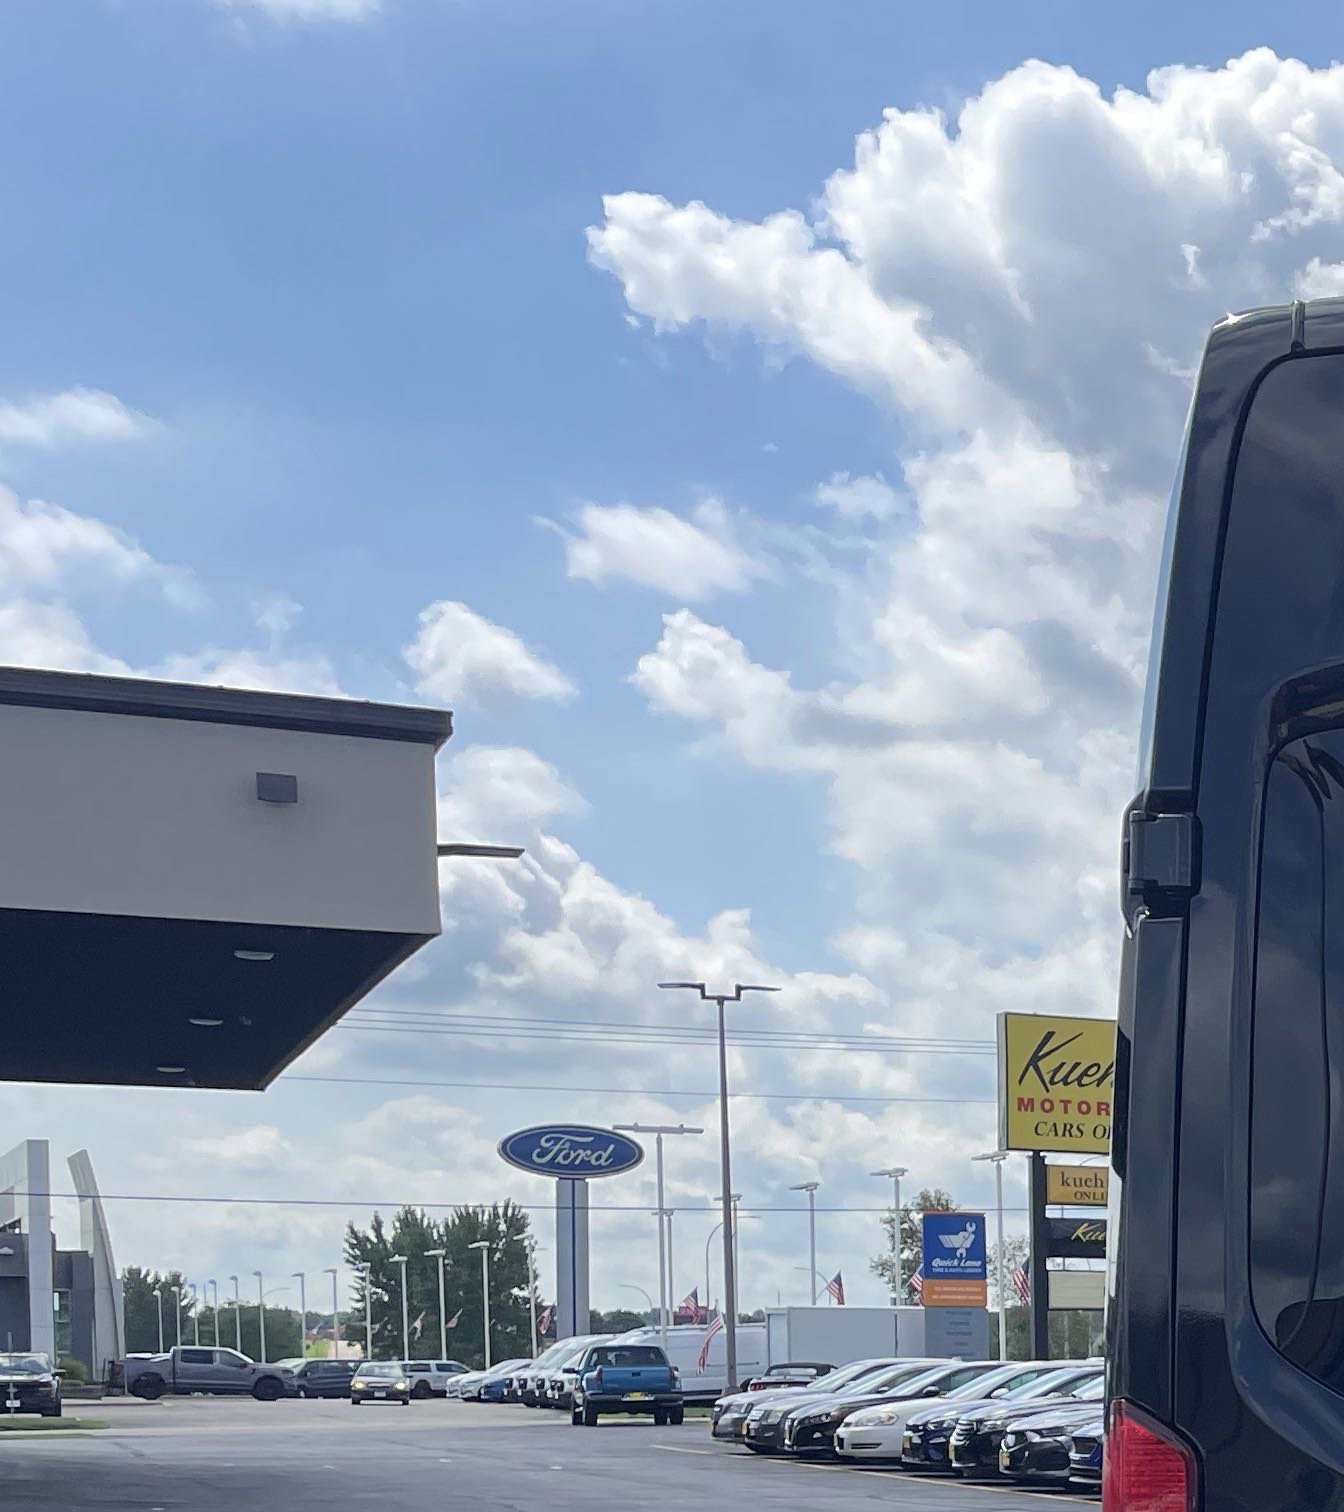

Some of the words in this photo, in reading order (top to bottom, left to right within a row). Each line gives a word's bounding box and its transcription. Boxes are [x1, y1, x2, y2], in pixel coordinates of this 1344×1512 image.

[1017, 1097, 1111, 1117] MOTOR
[1034, 1121, 1085, 1139] CARS
[531, 1133, 616, 1166] Ford
